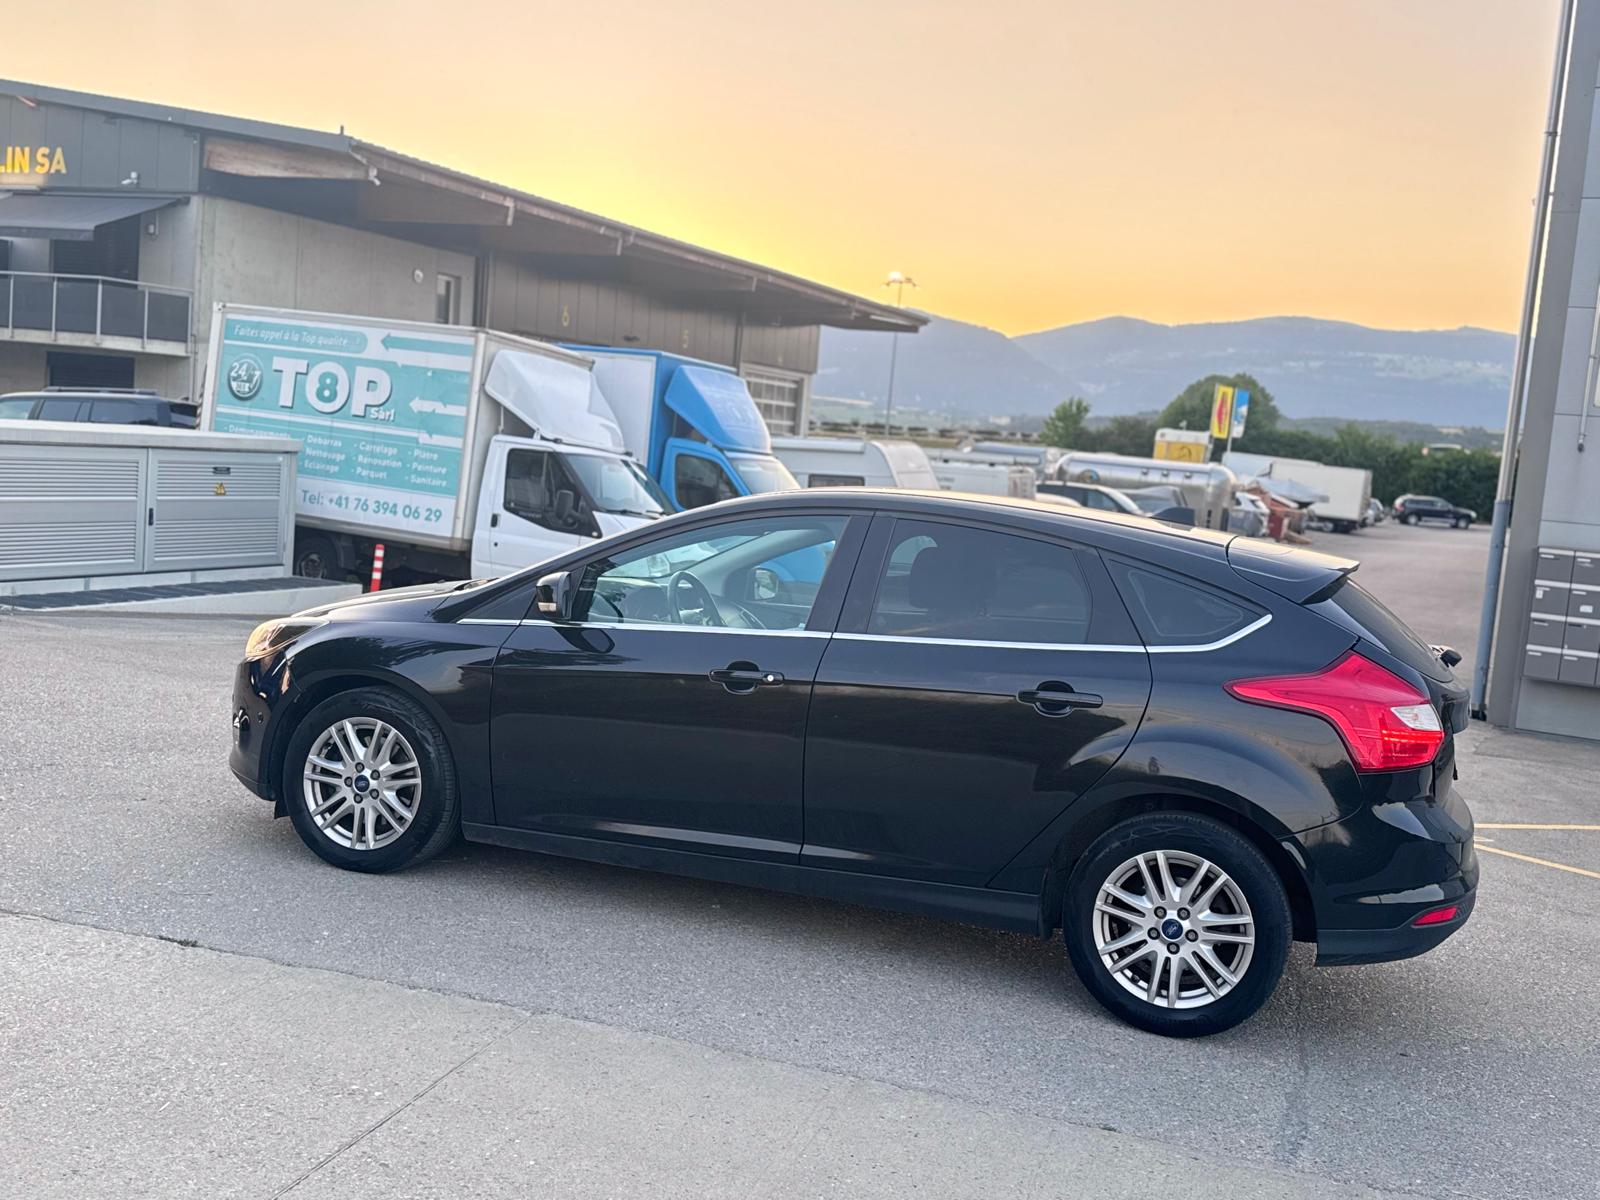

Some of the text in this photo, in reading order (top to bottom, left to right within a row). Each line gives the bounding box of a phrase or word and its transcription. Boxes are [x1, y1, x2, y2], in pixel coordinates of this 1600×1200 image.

[0, 146, 67, 174] IN SA
[260, 329, 283, 342] appel
[301, 331, 317, 345] Top
[272, 355, 393, 419] TOP
[356, 466, 387, 480] Parquet
[412, 462, 447, 474] Peinture
[410, 474, 447, 487] Sanitaire
[328, 495, 349, 509] +41
[353, 497, 369, 512] 76
[372, 500, 398, 516] 394
[402, 504, 420, 520] 06
[424, 507, 443, 522] 29
